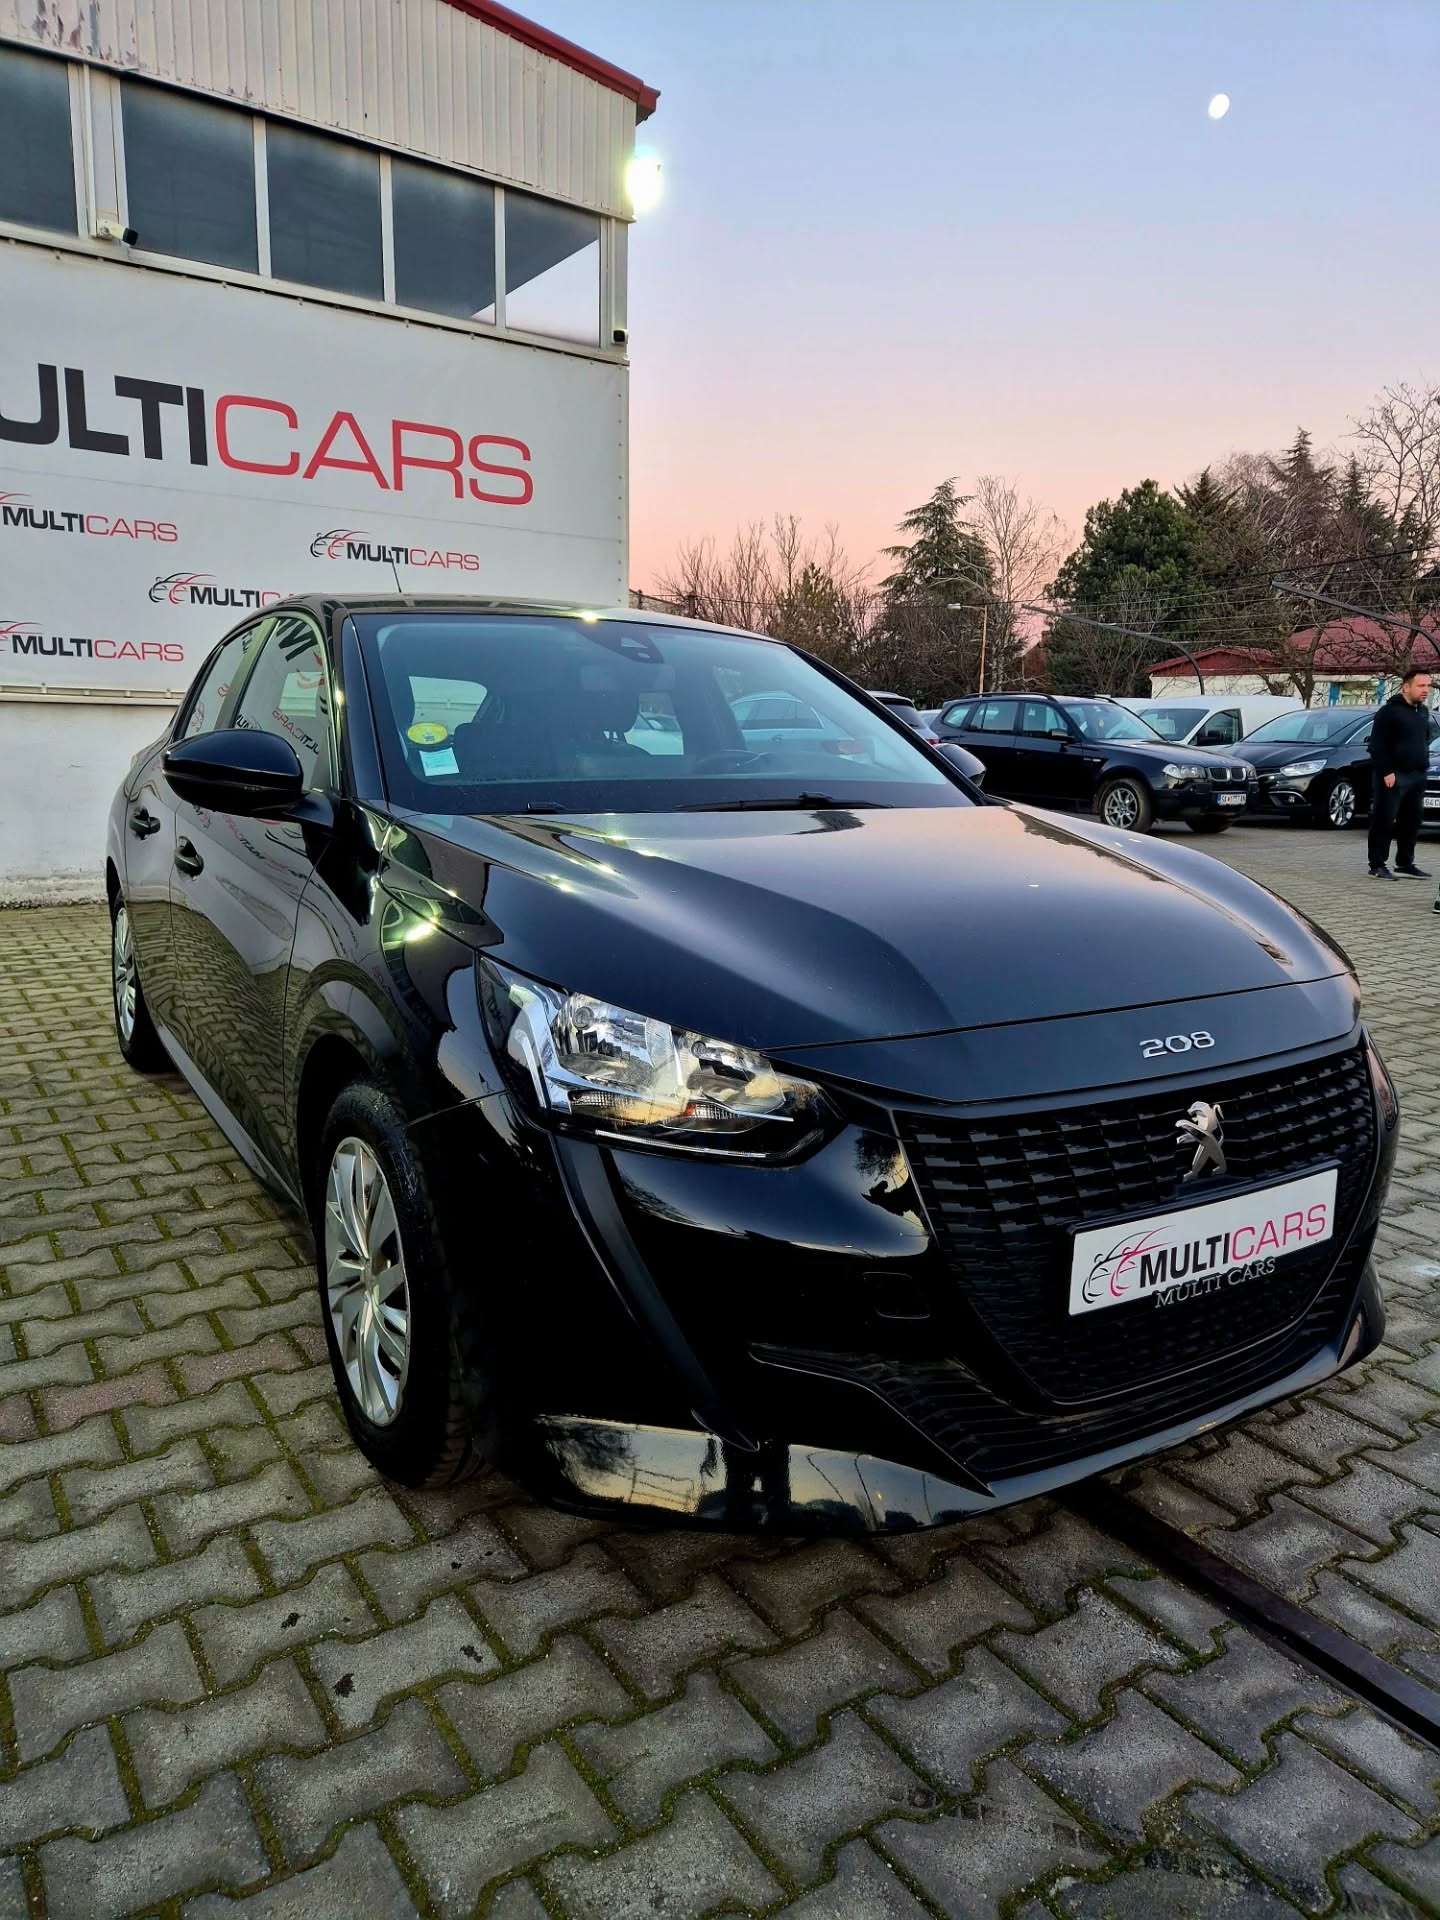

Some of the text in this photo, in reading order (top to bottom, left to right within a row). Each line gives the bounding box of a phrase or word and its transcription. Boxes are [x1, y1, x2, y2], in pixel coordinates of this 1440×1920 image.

[0, 363, 534, 505] ULTICARS
[3, 506, 178, 542] MULTICARS
[347, 542, 480, 571] MULTICARS
[12, 634, 184, 662] MULTICARS
[1140, 1031, 1215, 1059] 208
[1140, 1203, 1327, 1288] MULTICARS
[1154, 1258, 1276, 1309] MULTI CARS
